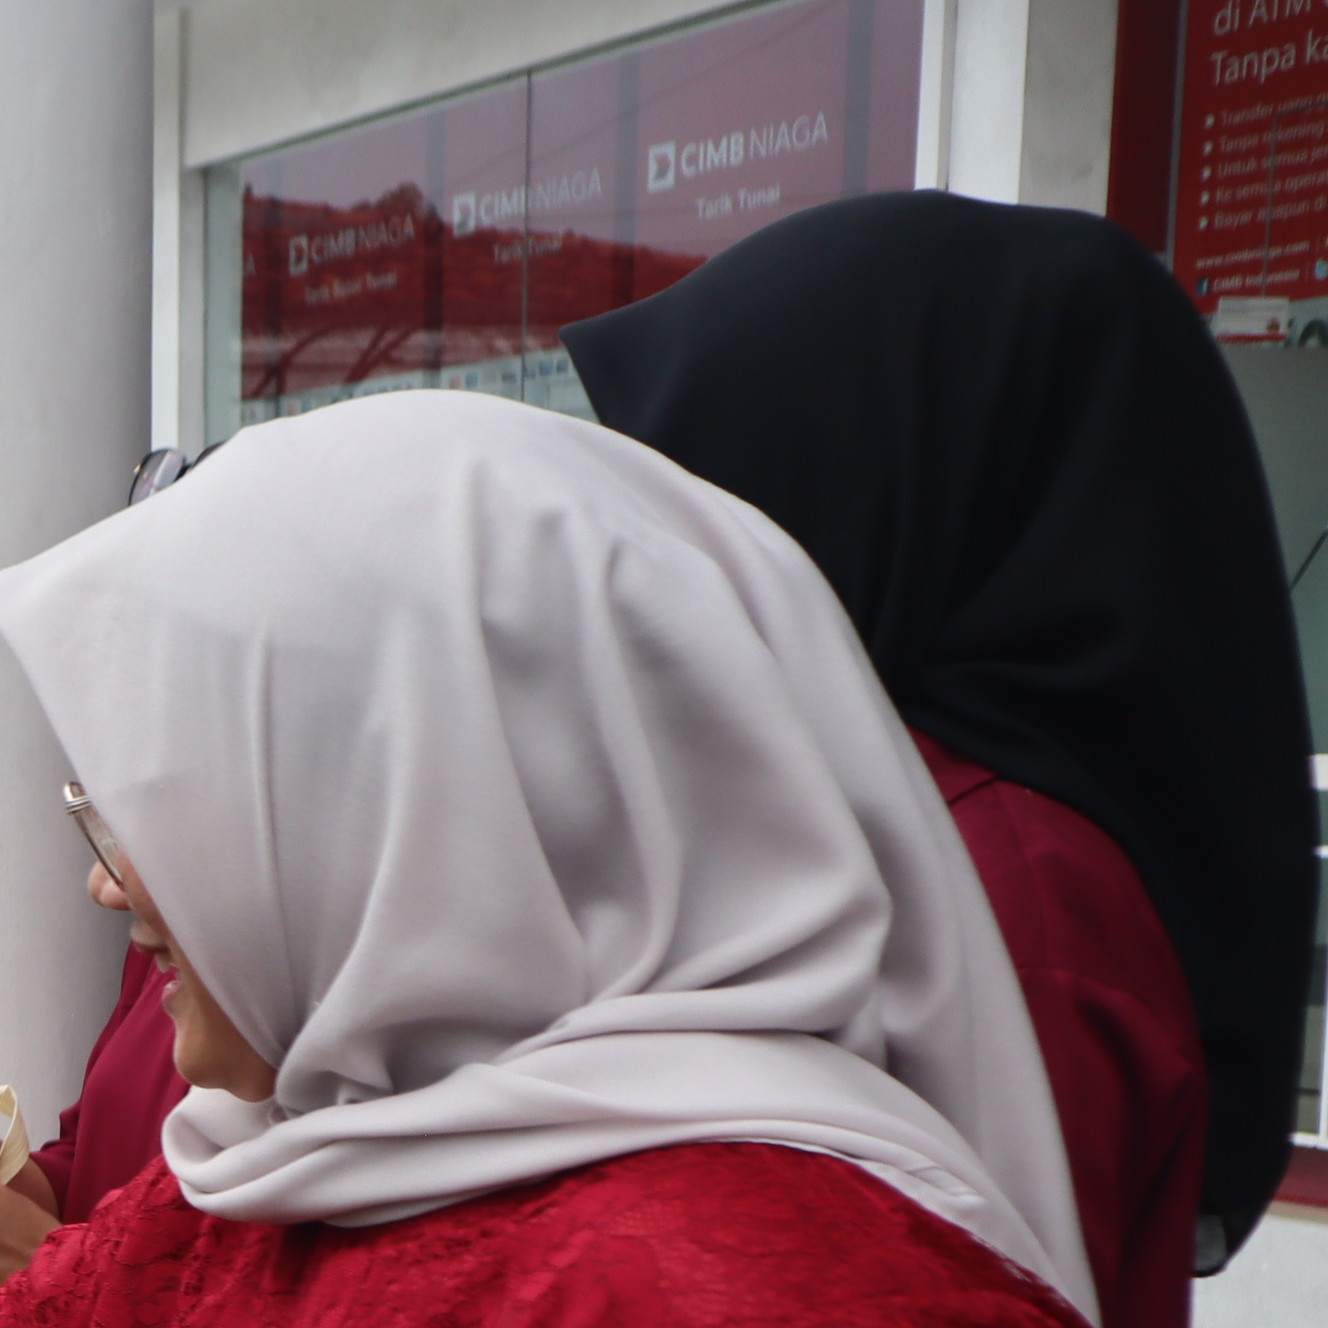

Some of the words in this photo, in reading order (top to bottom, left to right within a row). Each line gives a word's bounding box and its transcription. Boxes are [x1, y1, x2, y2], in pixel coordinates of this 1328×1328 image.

[1211, 42, 1297, 86] Tanpa
[679, 130, 745, 179] CIMB
[750, 109, 829, 161] NIAGA
[535, 165, 603, 210] NIAGA
[696, 191, 734, 221] Tarik
[737, 181, 782, 211] Tunai
[310, 227, 356, 266] CIMB
[357, 212, 416, 250] NIAGA
